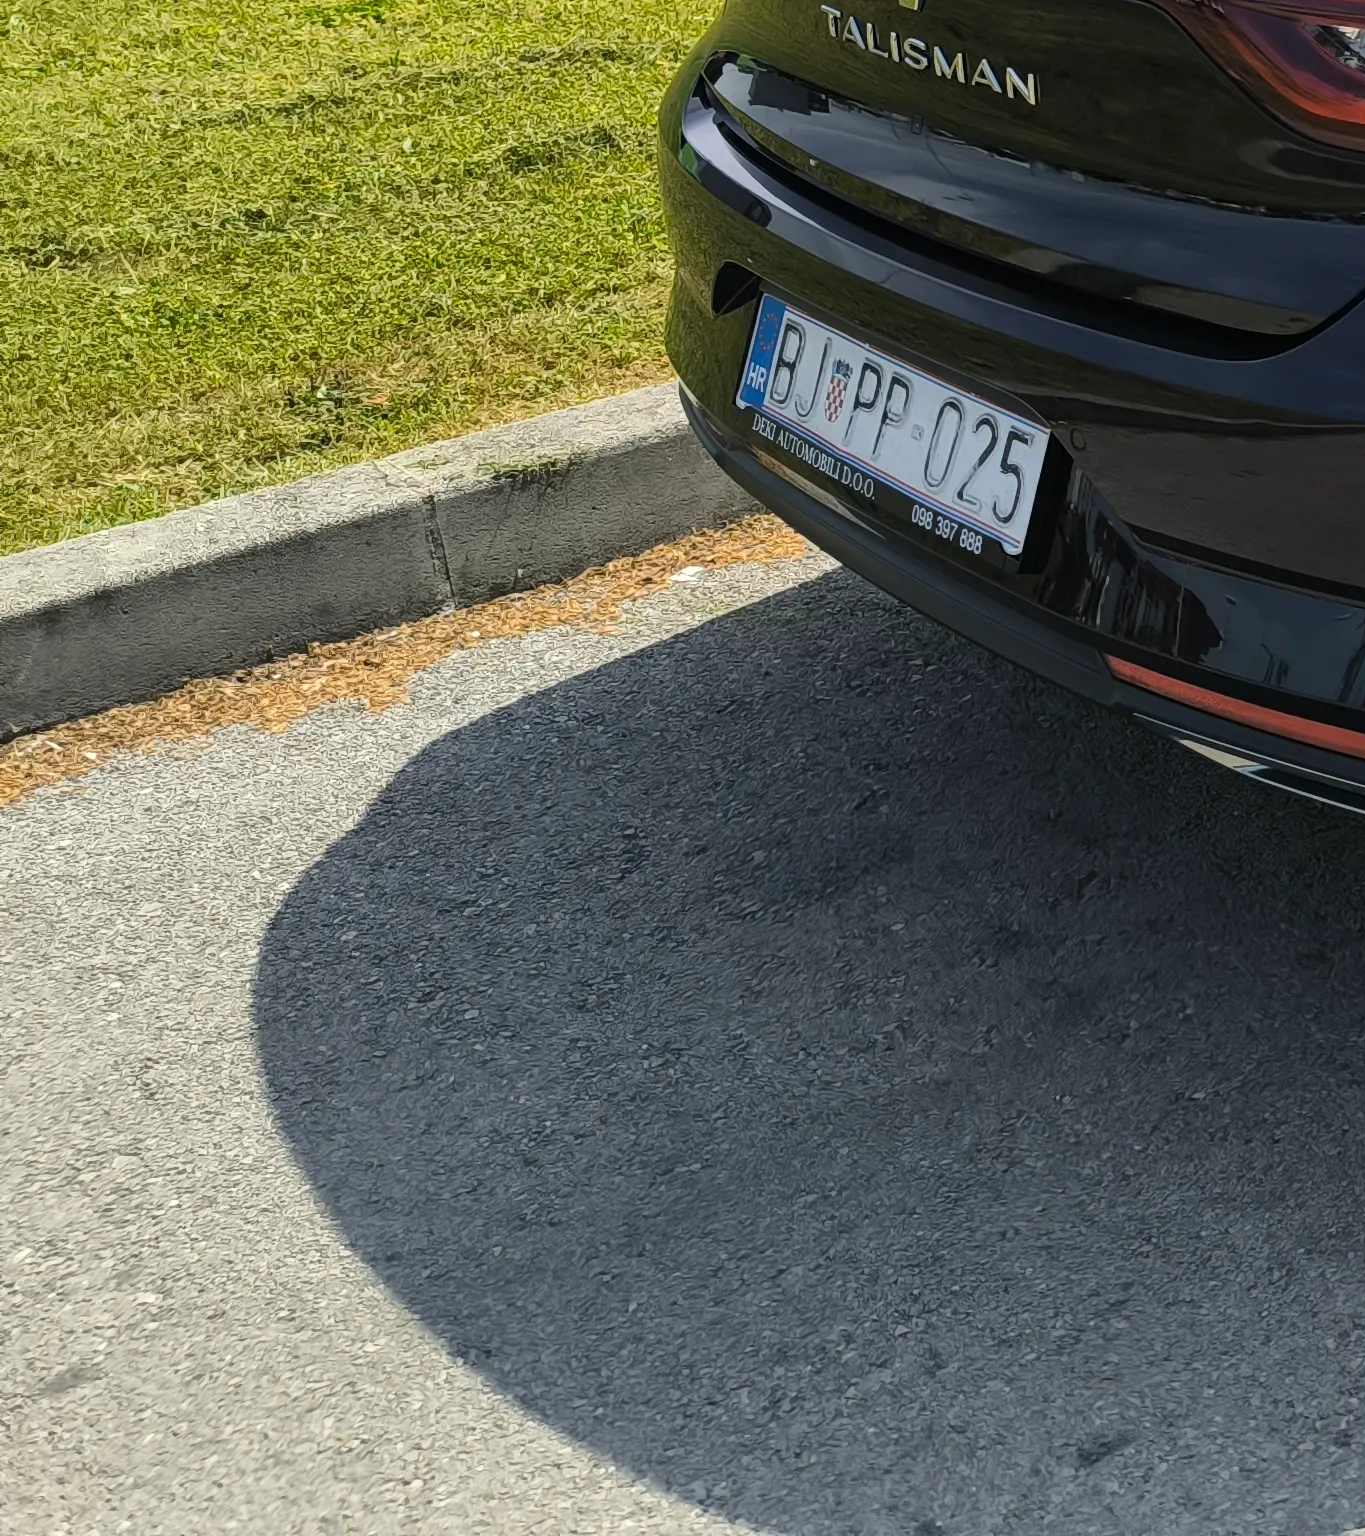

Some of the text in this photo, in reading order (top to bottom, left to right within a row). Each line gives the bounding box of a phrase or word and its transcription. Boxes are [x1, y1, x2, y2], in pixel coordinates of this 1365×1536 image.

[821, 4, 1036, 105] TALISMAN
[747, 362, 767, 393] HR
[768, 318, 833, 422] BJ
[752, 413, 876, 500] DEKI AUTOMOBILI D.O.O.
[911, 504, 983, 555] 098 397 888
